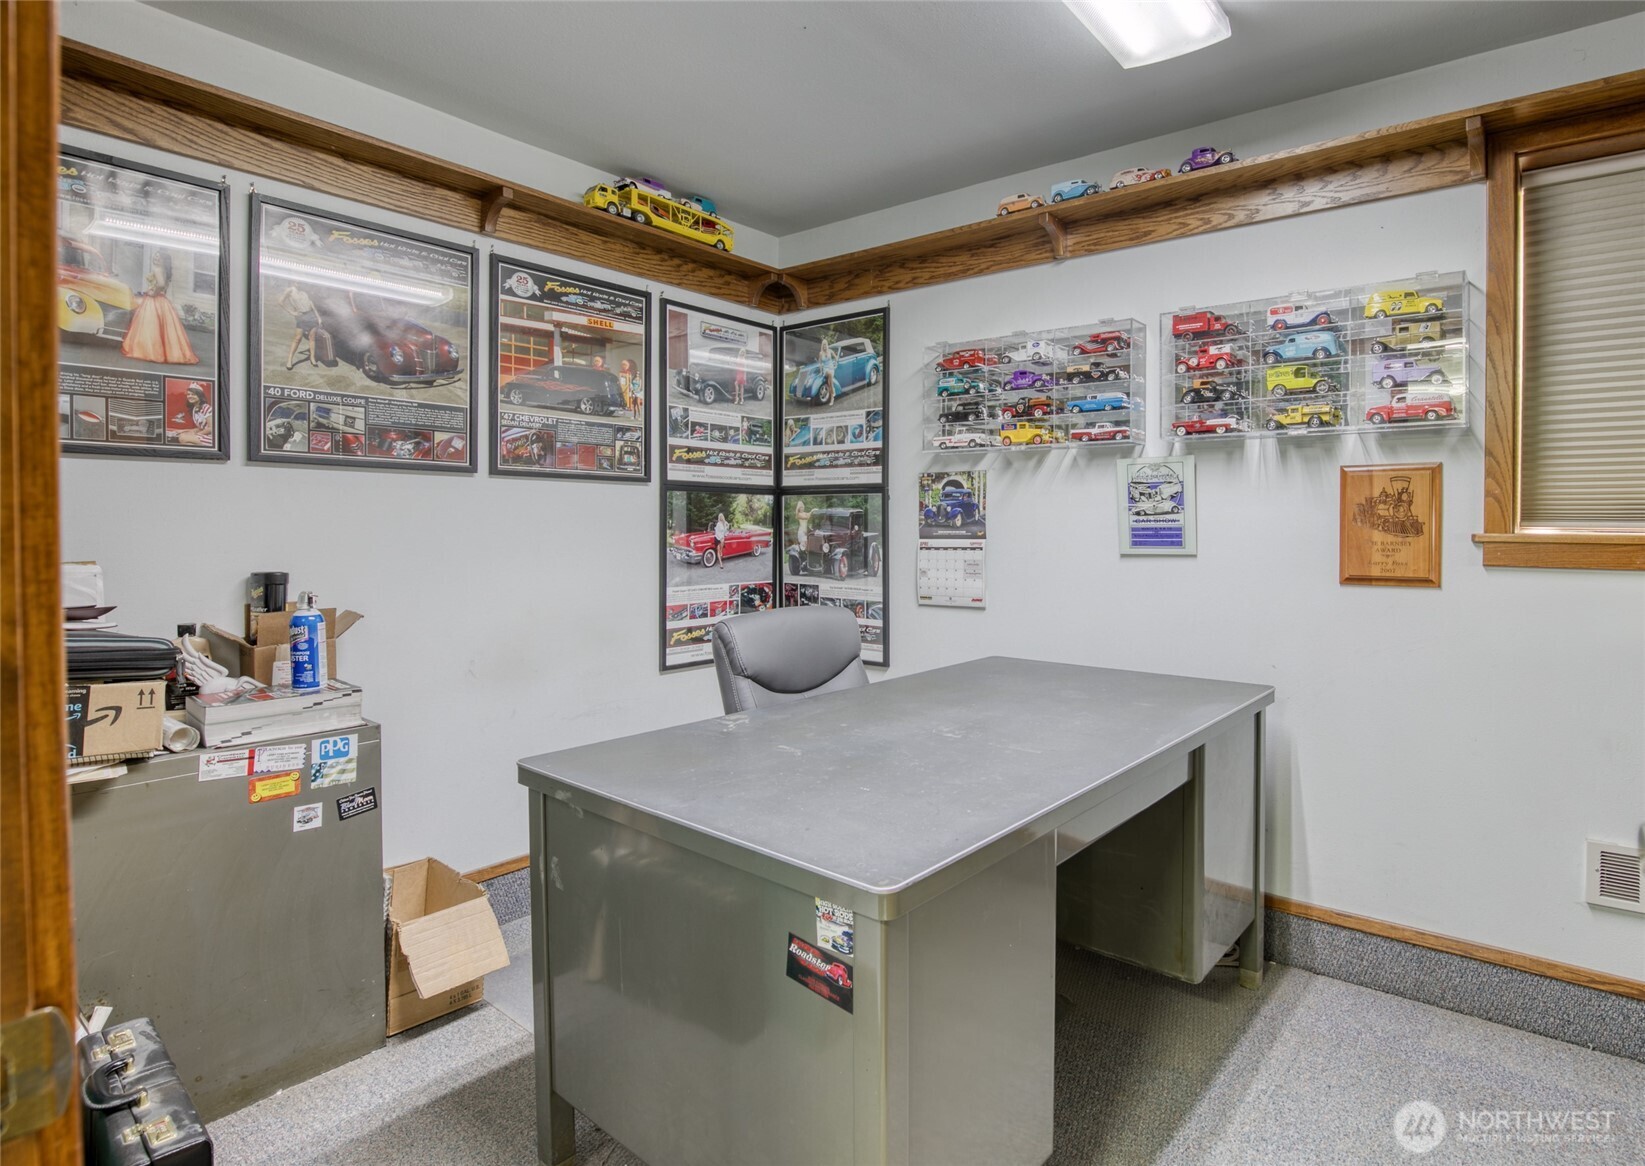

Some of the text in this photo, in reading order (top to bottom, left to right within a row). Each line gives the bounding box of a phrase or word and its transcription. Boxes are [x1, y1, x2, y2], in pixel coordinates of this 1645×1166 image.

[288, 221, 305, 233] 25
[516, 276, 529, 284] 25
[544, 281, 579, 294] Fosses
[587, 319, 614, 328] SHELL
[284, 389, 314, 399] FORD
[315, 394, 341, 402] DELUXE
[514, 414, 557, 424] CHEVROLET
[672, 448, 706, 461] Fosses
[787, 455, 817, 468] Fosses
[670, 629, 705, 645] Fosses
[321, 738, 348, 756] PPG
